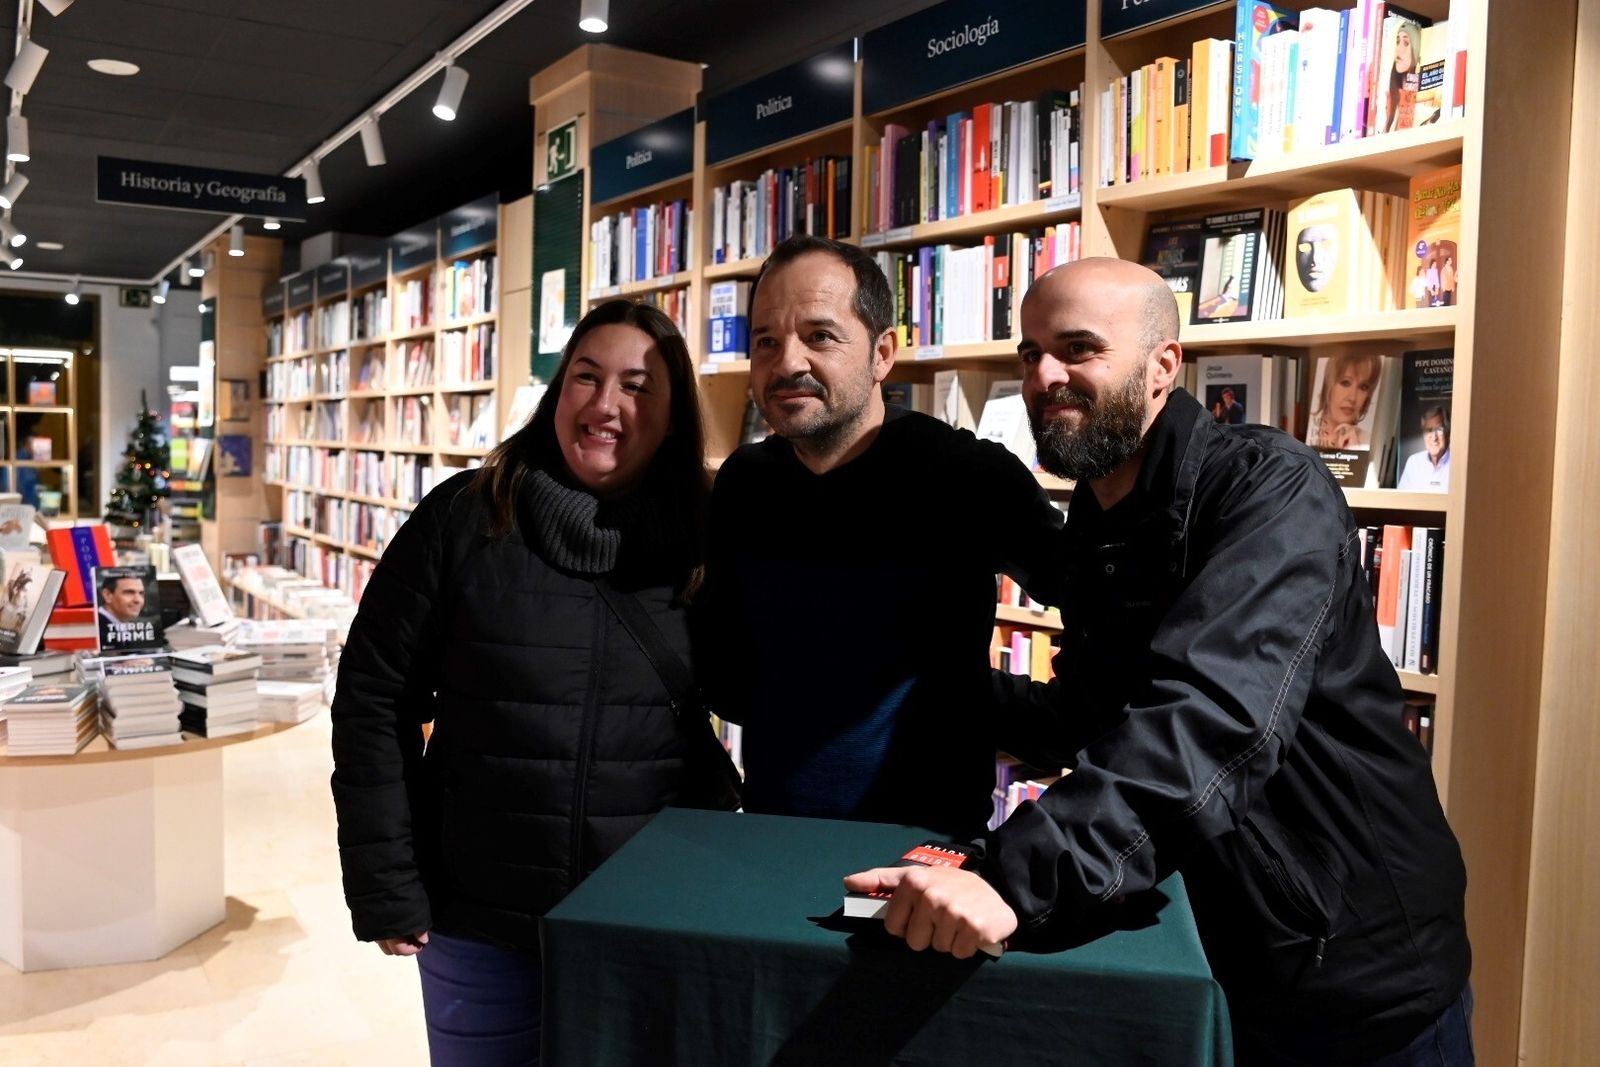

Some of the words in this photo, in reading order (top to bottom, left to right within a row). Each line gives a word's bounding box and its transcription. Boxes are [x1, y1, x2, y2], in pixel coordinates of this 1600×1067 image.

[927, 16, 999, 58] Sociología
[1234, 31, 1246, 117] HERSTORY
[121, 171, 191, 193] Historia
[192, 183, 204, 198] y
[207, 181, 287, 203] Geografía
[1430, 358, 1453, 366] DOMIN
[107, 621, 154, 632] TIERRA
[107, 631, 155, 643] FIRME
